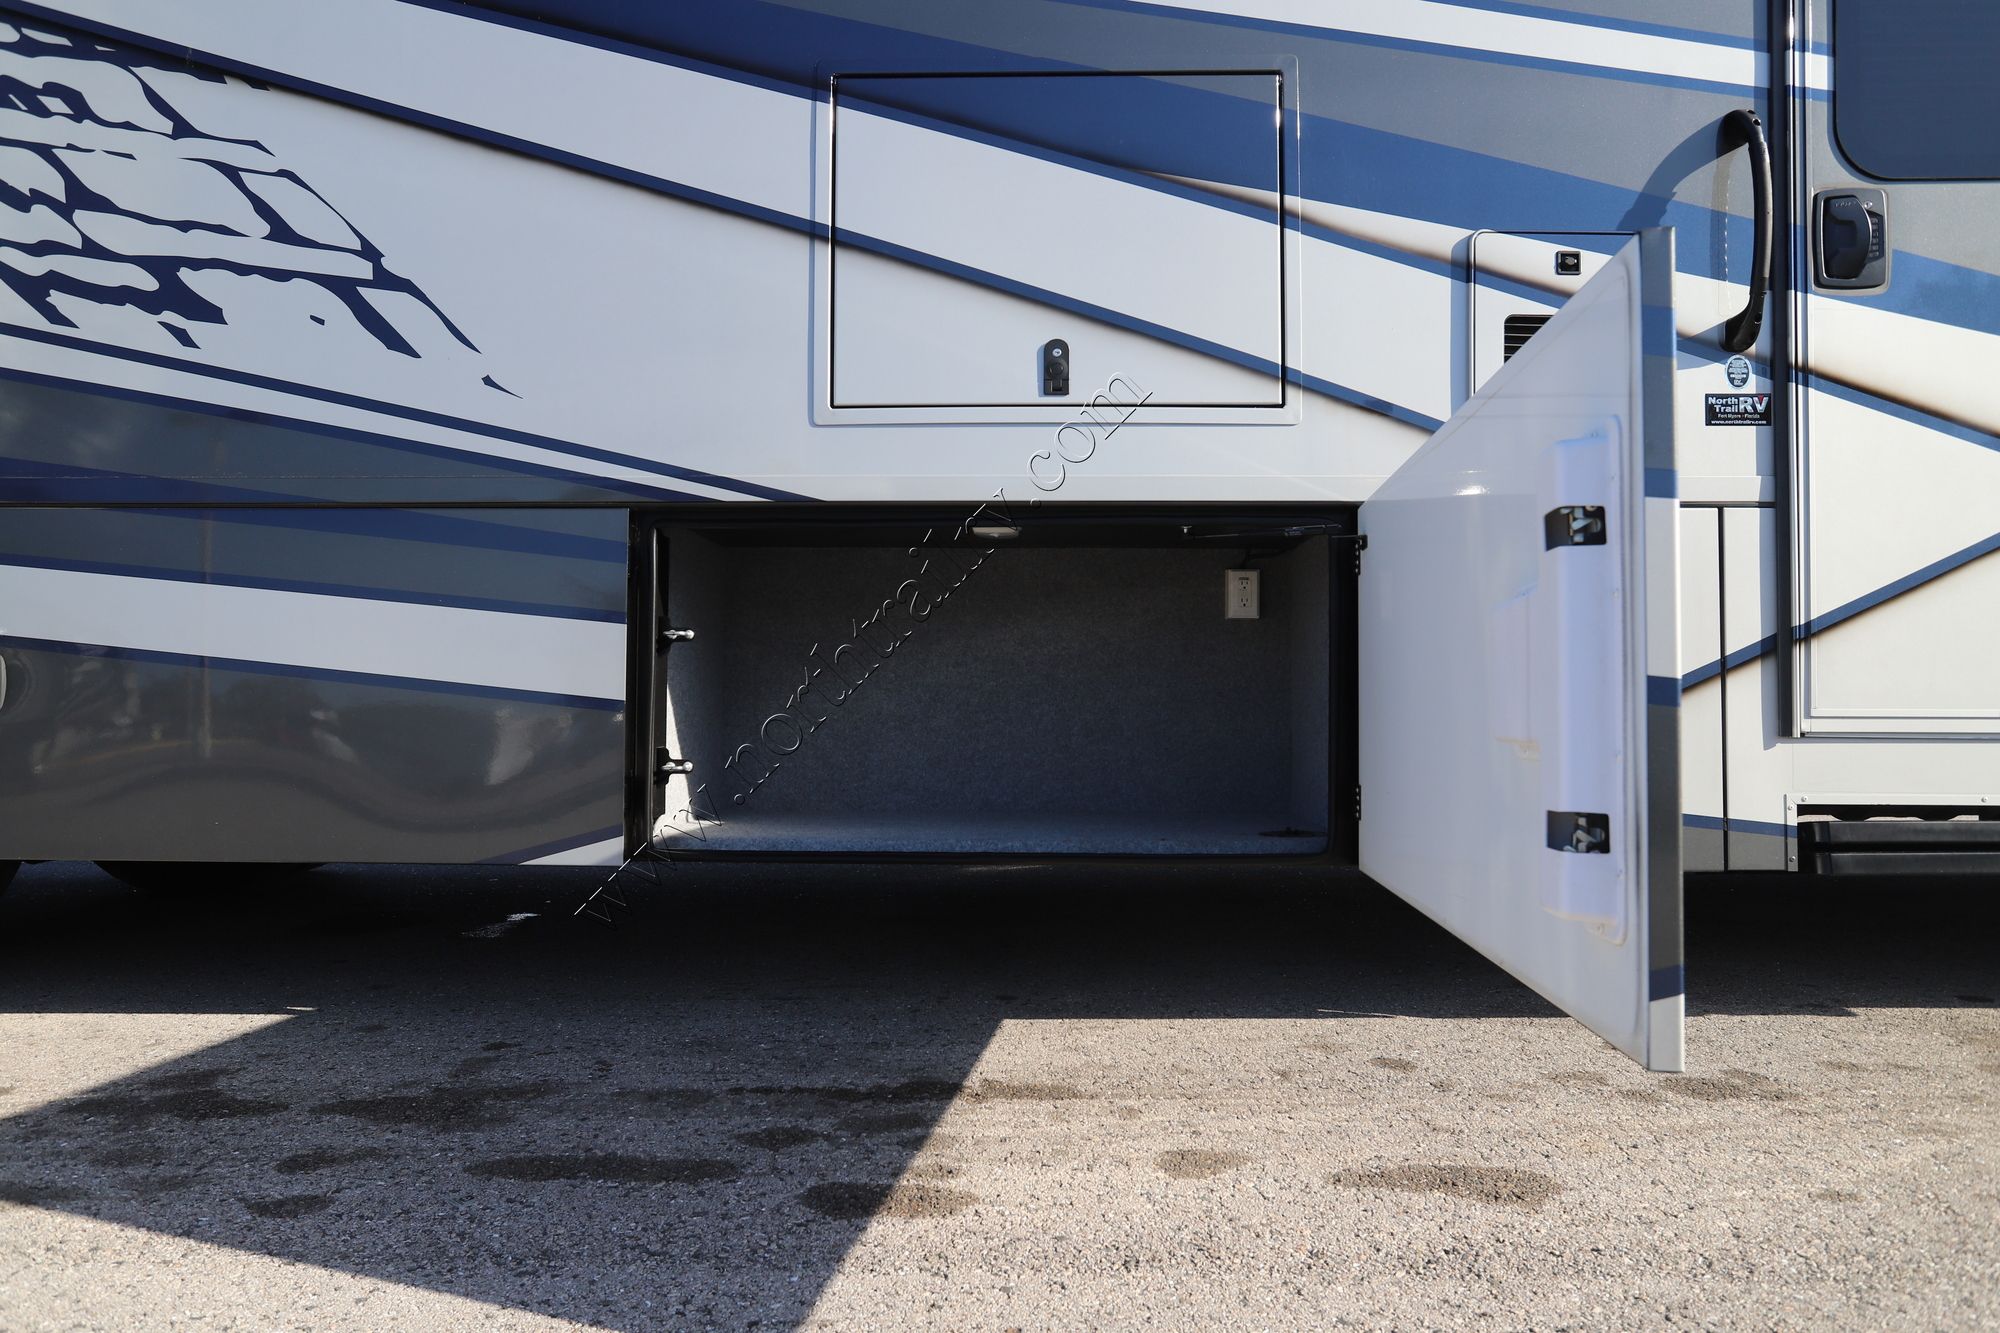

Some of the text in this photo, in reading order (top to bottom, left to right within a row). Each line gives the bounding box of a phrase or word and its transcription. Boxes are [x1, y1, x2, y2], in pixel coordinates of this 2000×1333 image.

[1708, 396, 1769, 413] North RV
[1714, 404, 1738, 412] Trail
